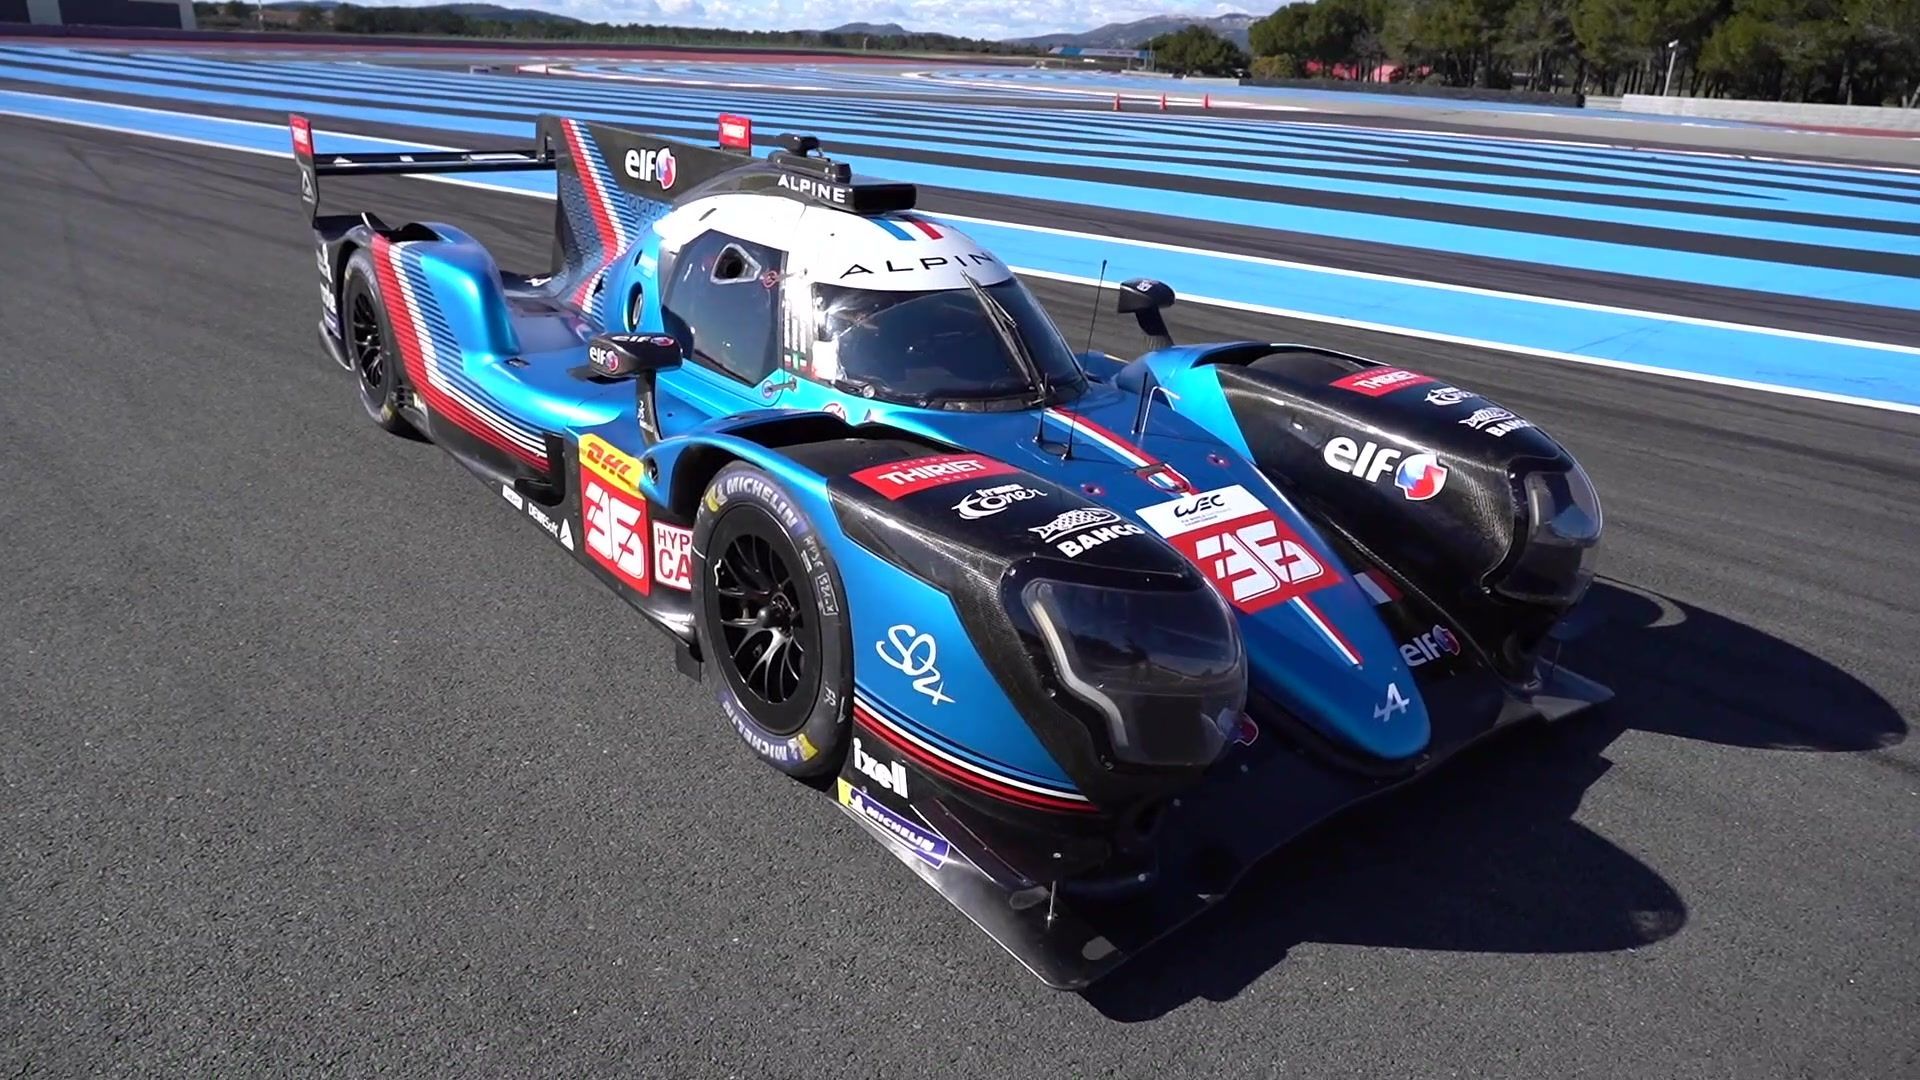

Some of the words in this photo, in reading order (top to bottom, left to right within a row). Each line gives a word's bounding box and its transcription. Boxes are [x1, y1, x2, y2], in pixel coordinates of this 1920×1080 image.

[624, 149, 659, 182] elf
[776, 173, 847, 204] ALPINE
[839, 251, 997, 280] ALPIN
[589, 346, 607, 365] elf
[586, 442, 635, 490] DHL
[876, 459, 987, 486] THIRIET
[1323, 436, 1402, 483] elf
[726, 475, 798, 529] MICHELIN
[1173, 494, 1225, 518] WEC
[584, 481, 644, 579] 36
[656, 527, 691, 552] HYP
[1056, 522, 1146, 558] BAHCO
[658, 548, 692, 585] CA
[1195, 520, 1324, 602] 36
[1399, 632, 1441, 667] elf
[722, 700, 788, 761] MICHELIN
[852, 737, 909, 799] ixell
[865, 806, 936, 852] MICHELIN
